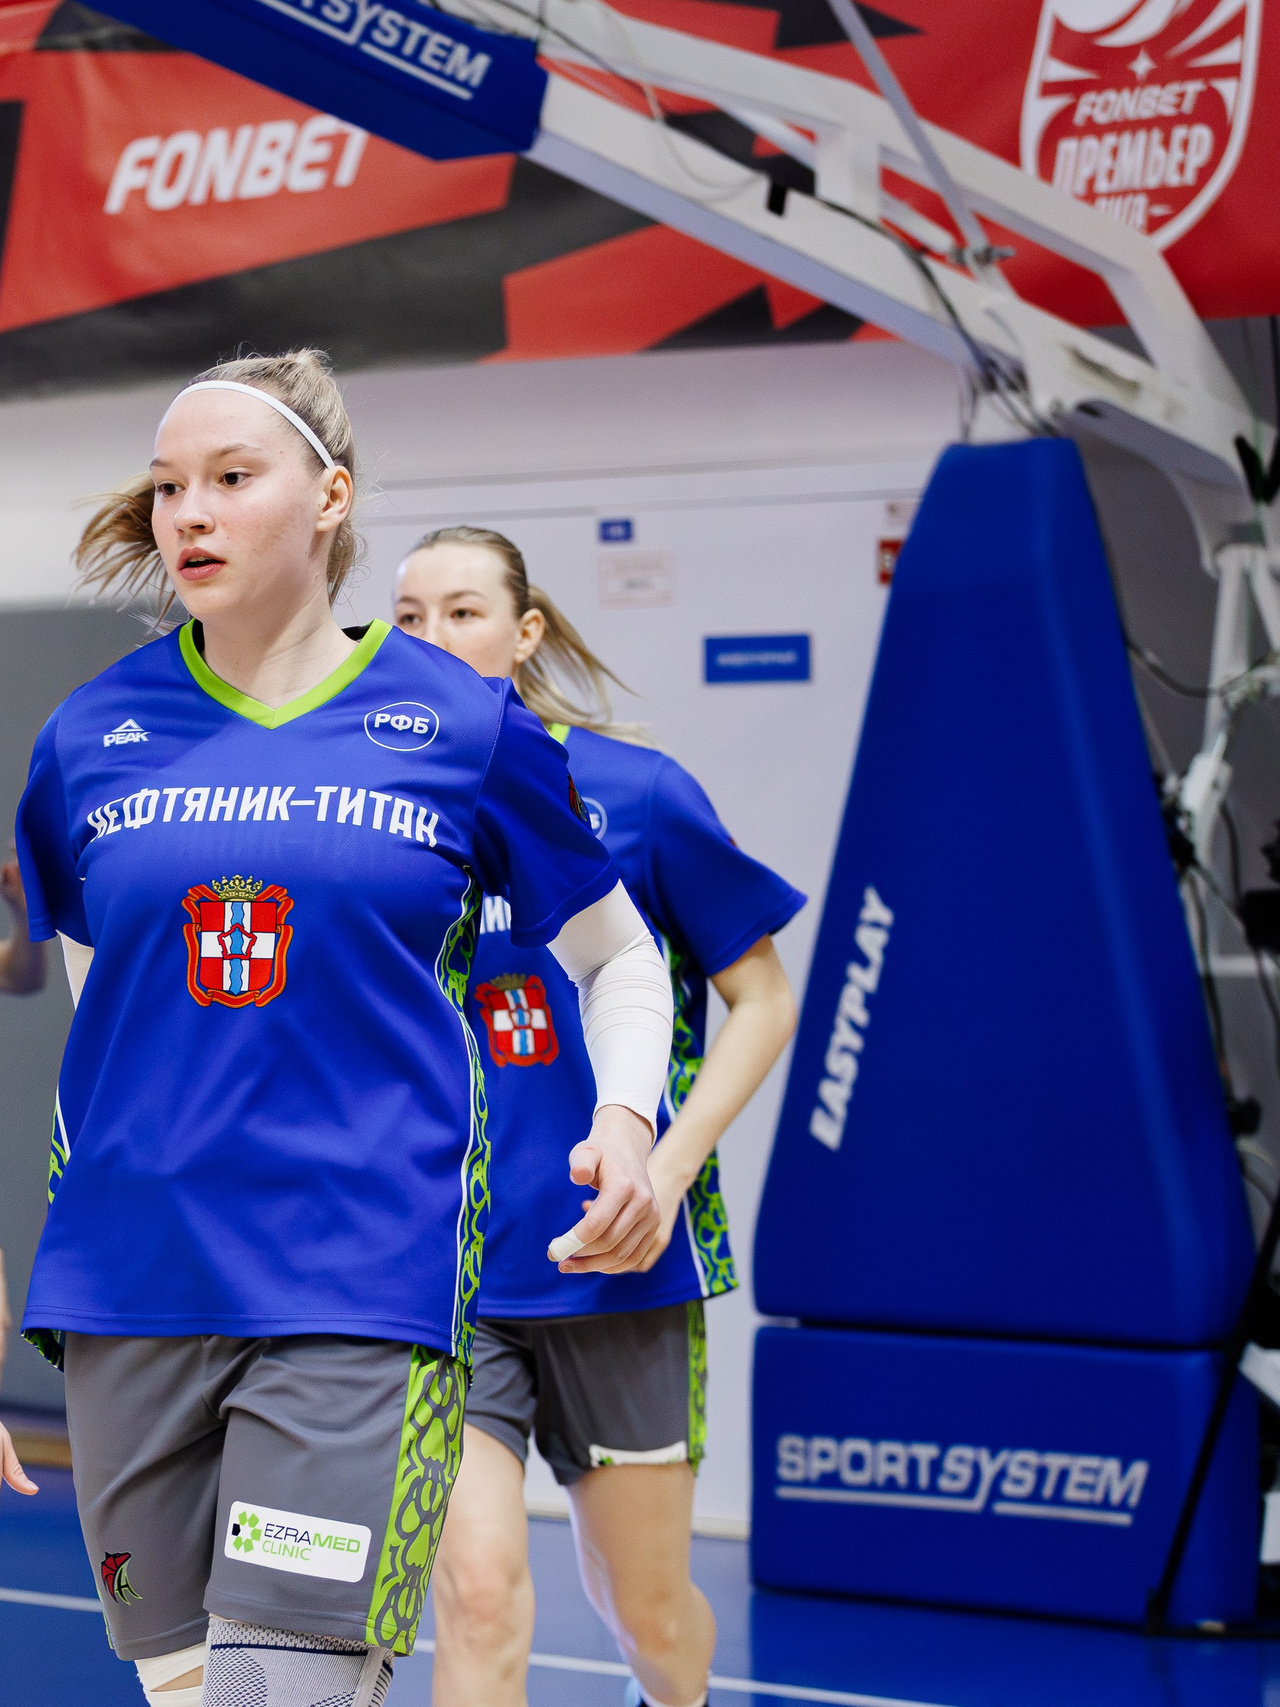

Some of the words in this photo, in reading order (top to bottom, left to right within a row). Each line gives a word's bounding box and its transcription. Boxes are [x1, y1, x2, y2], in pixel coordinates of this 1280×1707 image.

[301, 0, 491, 88] SYSTEM
[1073, 79, 1207, 127] FONBET
[103, 113, 372, 215] FONBET
[1052, 122, 1214, 195] ПРЕМЬЕР
[103, 731, 151, 747] PEAK
[373, 713, 430, 735] РФБ
[809, 884, 895, 1152] EASYPLAY
[776, 1433, 1149, 1511] SPORTSYSTEM
[261, 1540, 312, 1562] CLINIC
[264, 1523, 361, 1554] EZRAMED
